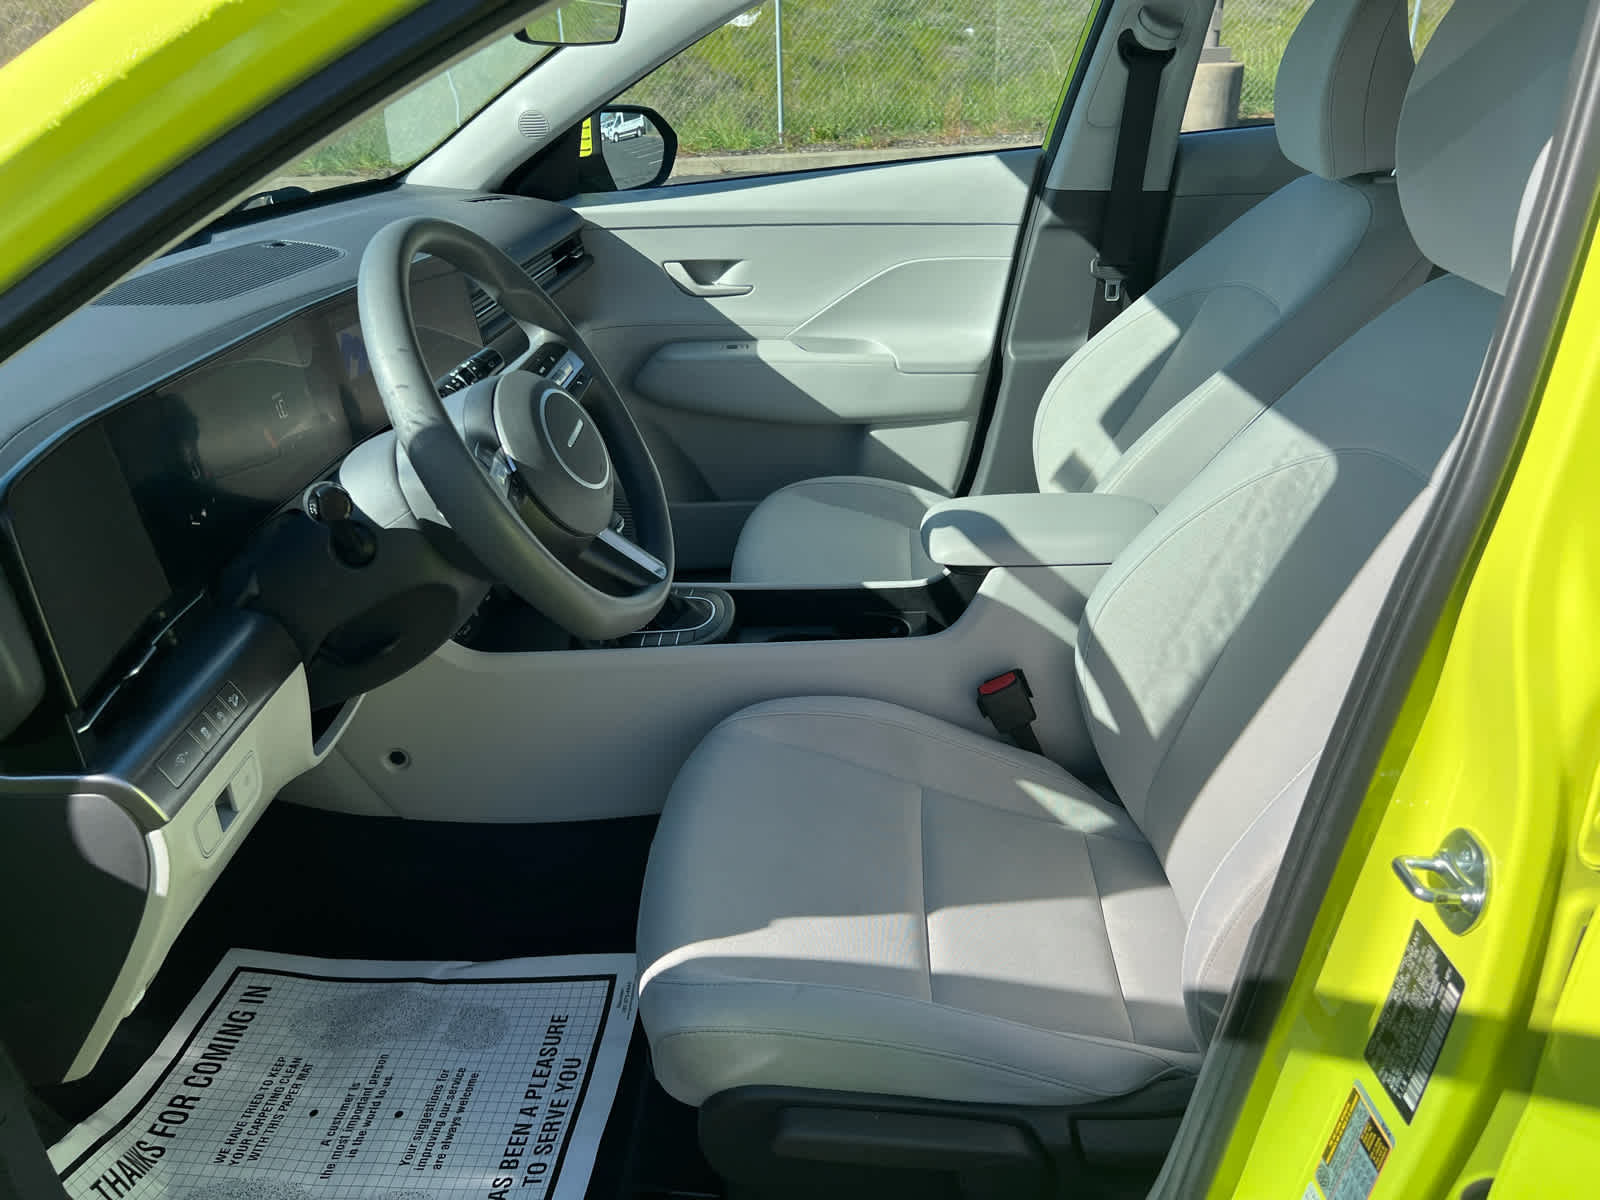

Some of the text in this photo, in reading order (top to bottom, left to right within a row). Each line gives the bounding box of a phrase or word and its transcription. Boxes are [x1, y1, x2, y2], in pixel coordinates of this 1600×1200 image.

[90, 985, 272, 1200] THANKS FOR COMING IN
[524, 1015, 568, 1099] PLEASURE
[213, 1057, 286, 1163] WE HAVE TRIED TO KEEP
[229, 1058, 302, 1166] YOUR CARPETING CLEAN
[247, 1063, 313, 1161] WITH THIS PAPER MAT
[320, 1054, 389, 1179] the most important person
[327, 1094, 355, 1137] customer
[348, 1082, 360, 1090] is
[345, 1148, 358, 1158] in
[352, 1130, 367, 1145] the
[362, 1101, 381, 1127] world
[375, 1090, 387, 1098] to
[399, 1069, 449, 1166] Your suggestions for
[414, 1067, 466, 1170] improving our service
[433, 1154, 446, 1170] are
[441, 1117, 461, 1150] always
[499, 1123, 533, 1170] BEEN
[520, 1106, 539, 1117] A
[522, 1058, 581, 1187] TO SERVE YOU
